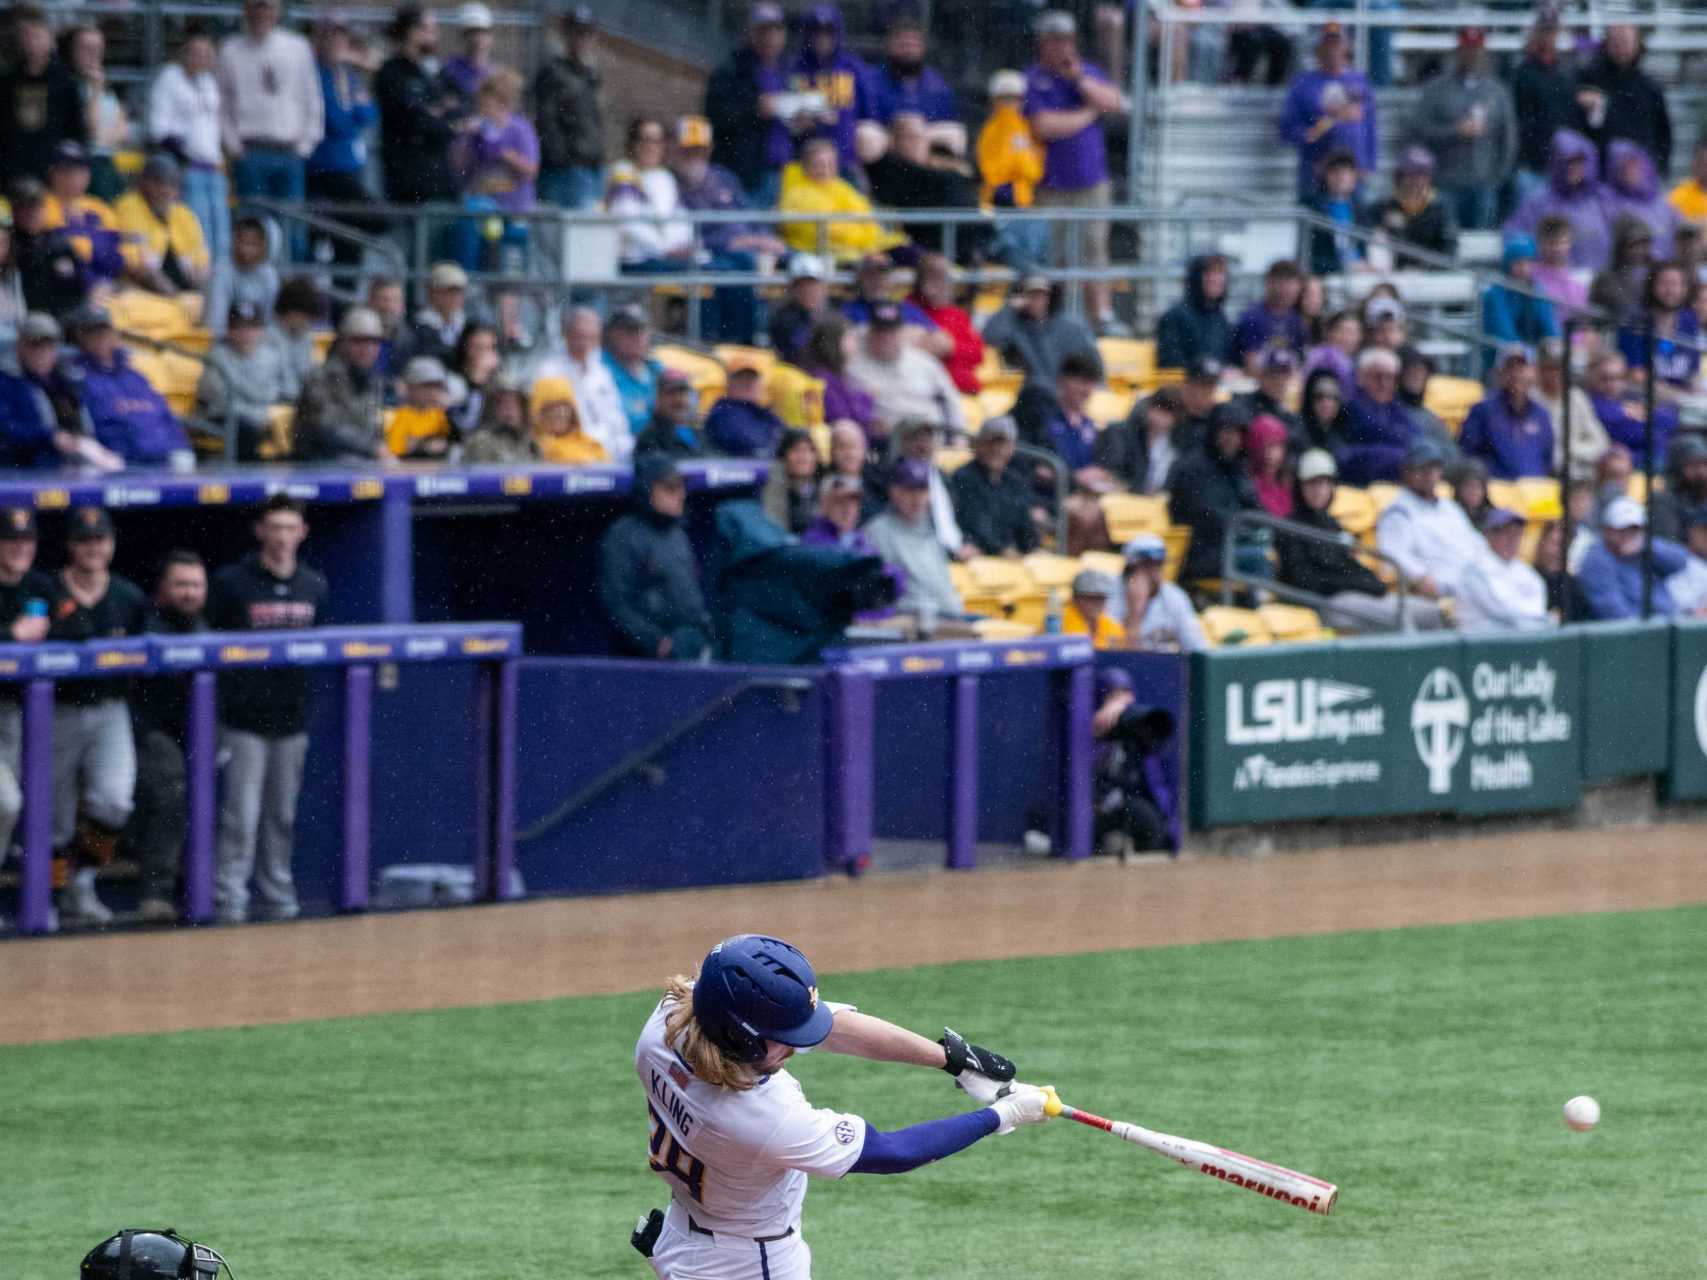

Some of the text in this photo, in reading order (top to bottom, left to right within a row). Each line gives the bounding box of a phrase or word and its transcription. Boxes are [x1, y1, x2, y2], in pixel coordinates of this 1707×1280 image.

[1226, 679, 1317, 744] LSU
[1472, 660, 1556, 707] Our Lady
[1471, 706, 1571, 745] of the Lake
[651, 1068, 694, 1137] KLING
